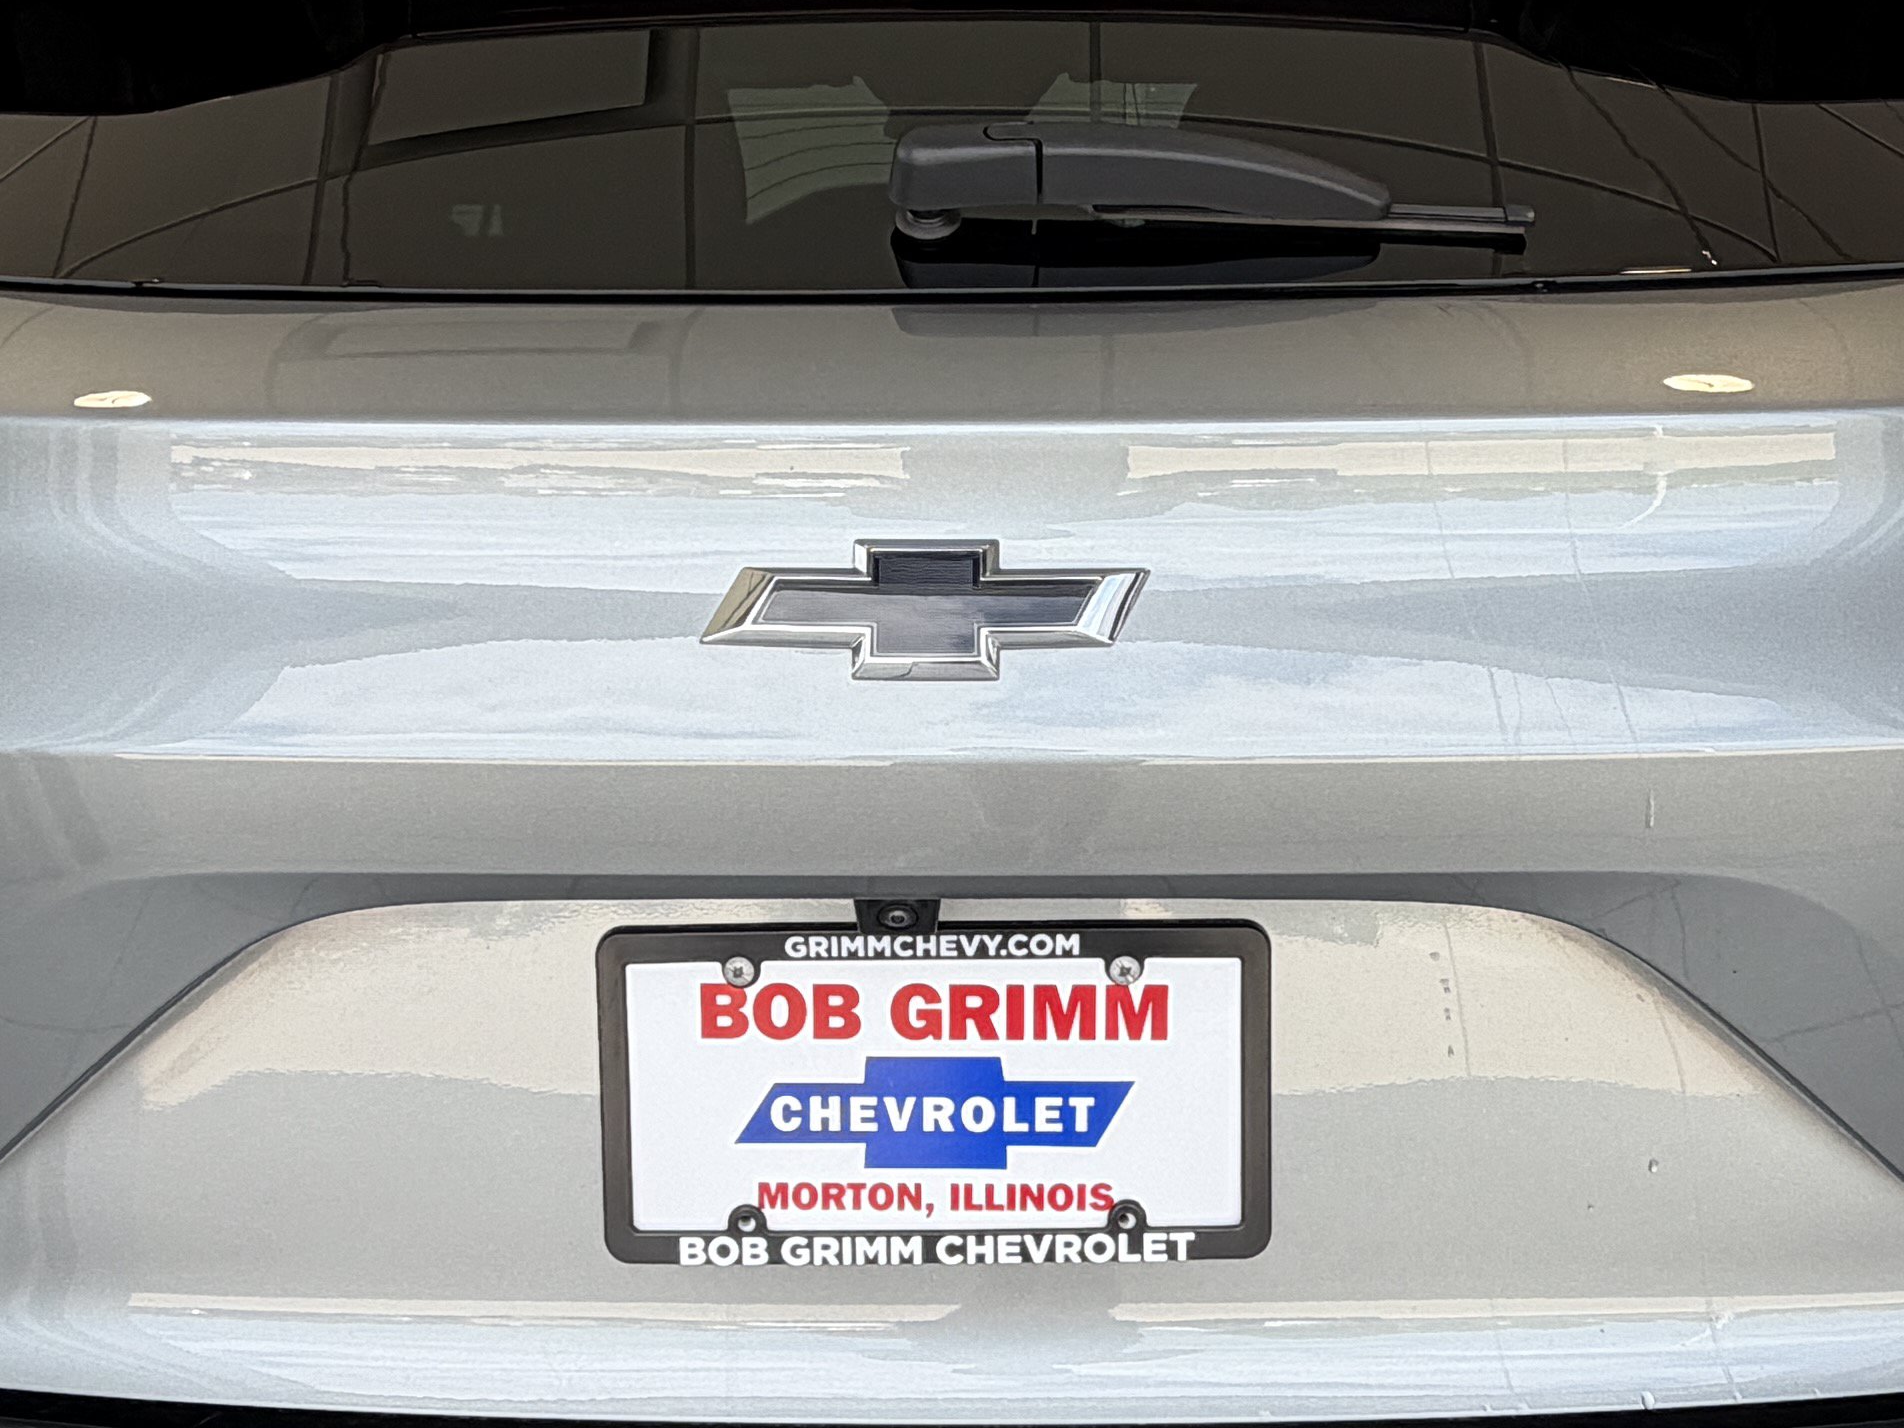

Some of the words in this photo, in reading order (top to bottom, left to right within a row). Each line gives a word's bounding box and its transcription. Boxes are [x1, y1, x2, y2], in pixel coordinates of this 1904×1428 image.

[784, 933, 1080, 958] GRIMMCHEVY.COM
[700, 982, 862, 1041] BOB
[890, 982, 1169, 1041] GRIMM
[770, 1095, 1096, 1133] CHEVROLET
[757, 1182, 935, 1218] MORTON,
[950, 1182, 1115, 1212] ILLINOIS
[679, 1236, 769, 1267] BOB
[780, 1235, 923, 1267] GRIMM
[935, 1231, 1196, 1266] CHEVROLET
